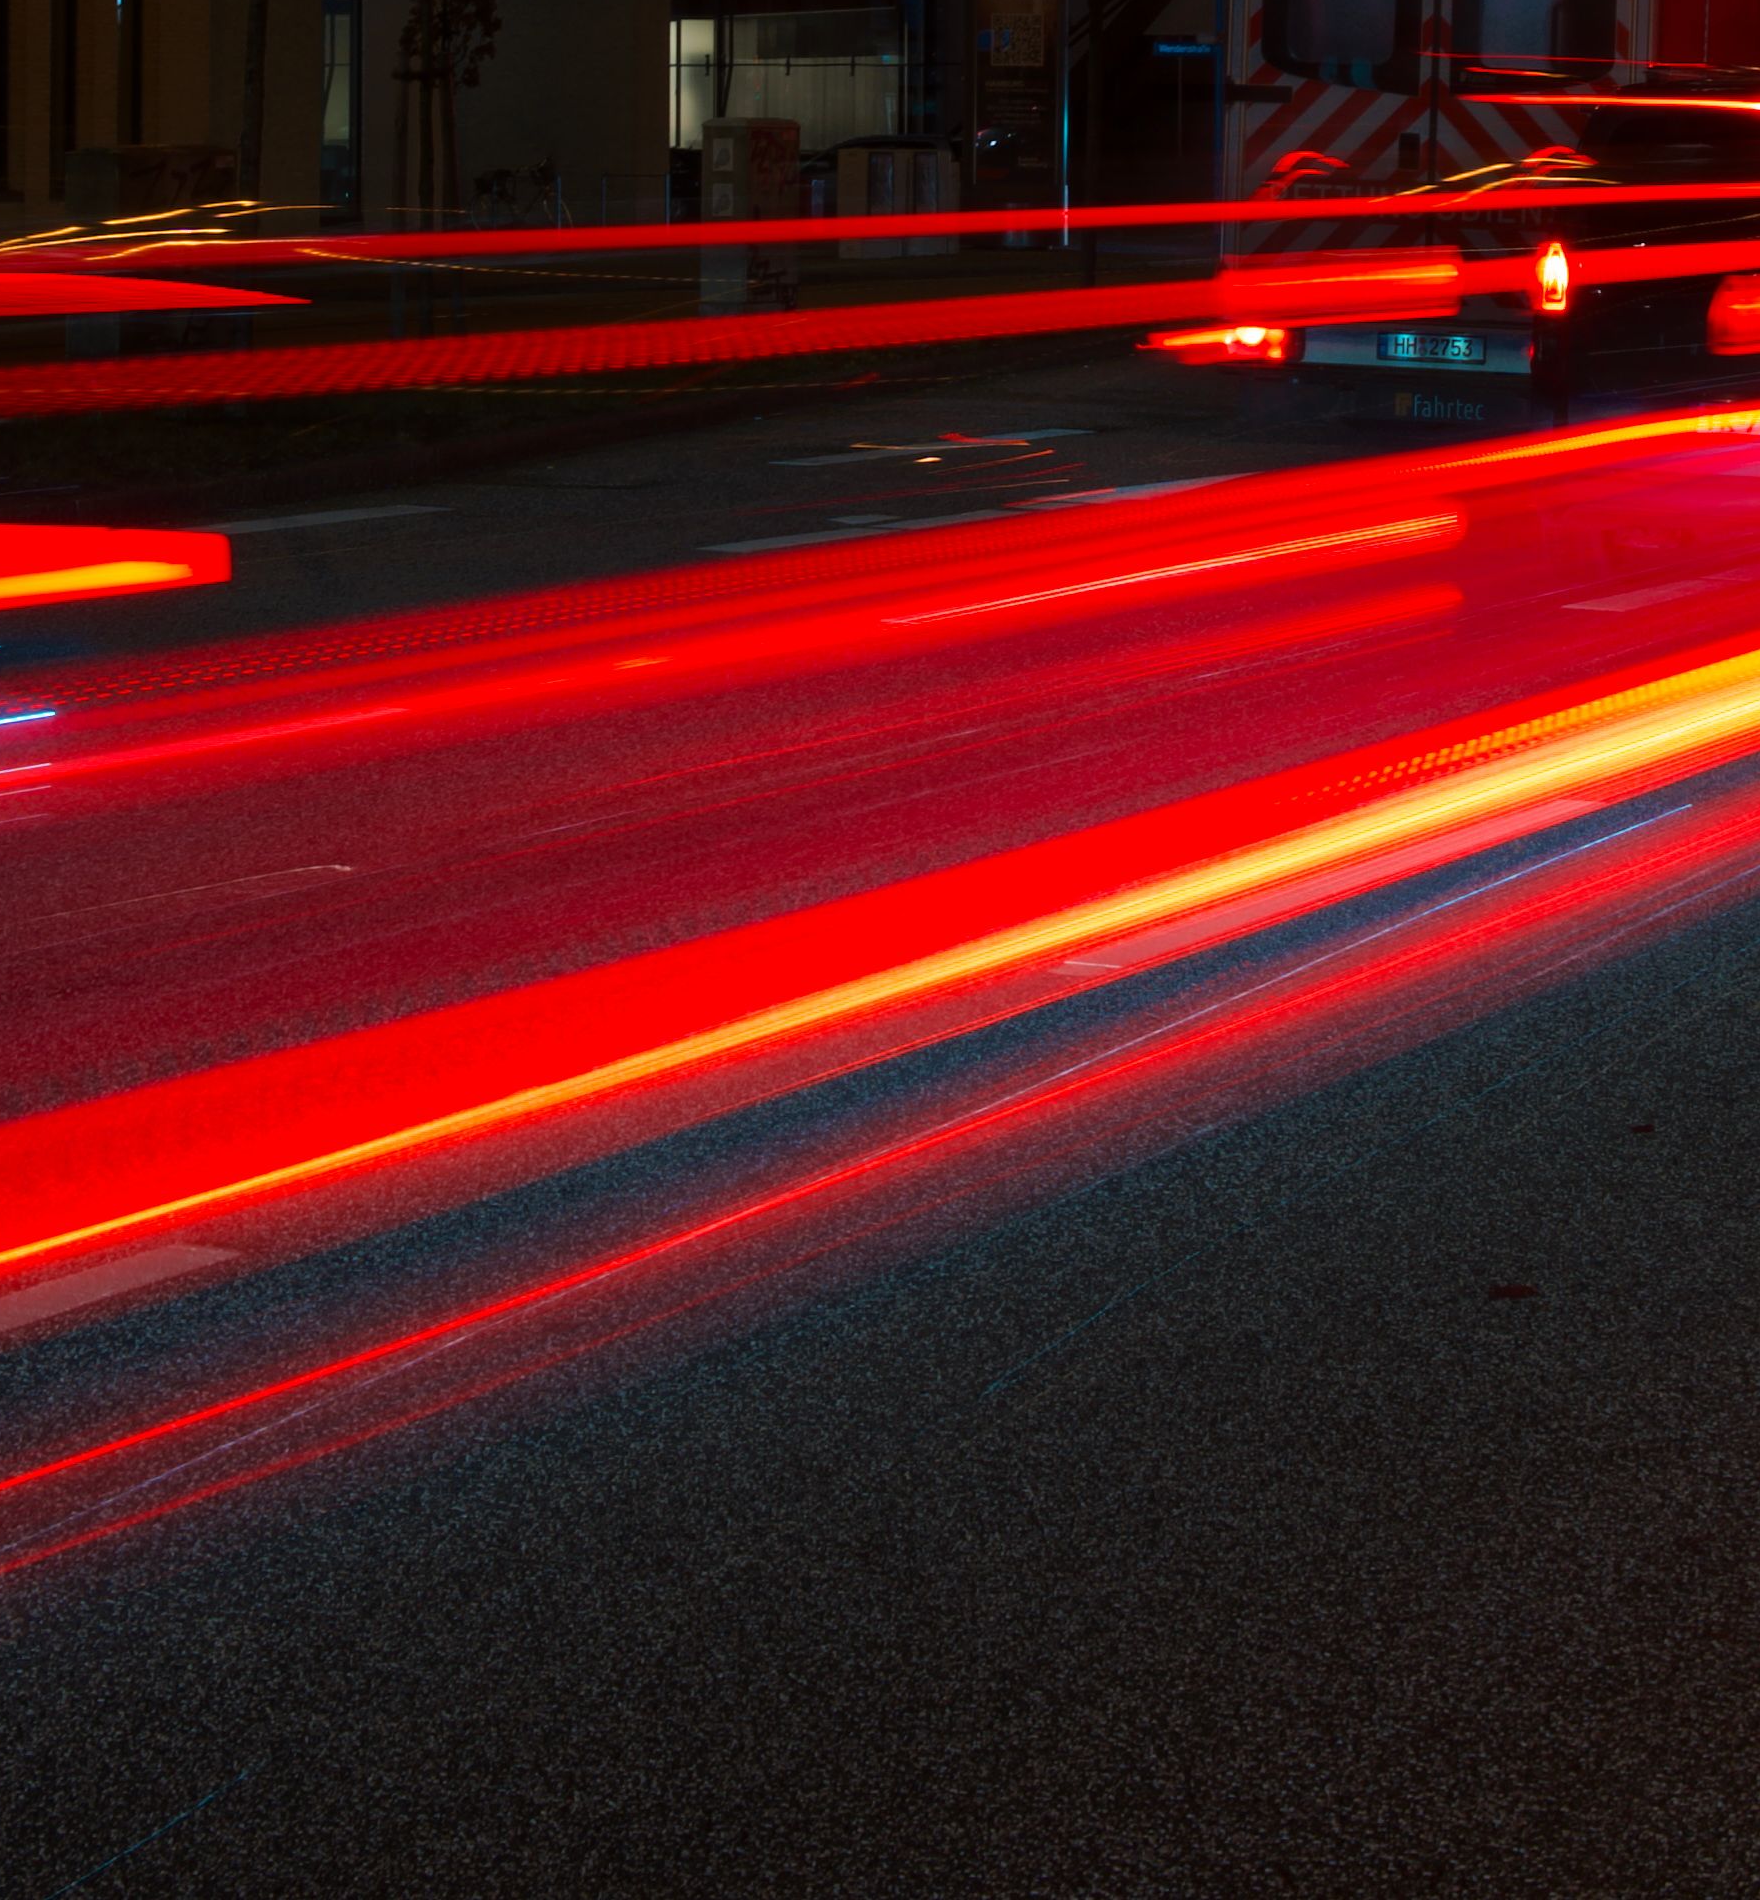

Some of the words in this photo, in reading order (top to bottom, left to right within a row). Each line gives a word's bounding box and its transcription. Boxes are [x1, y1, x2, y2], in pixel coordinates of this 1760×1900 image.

[1393, 336, 1418, 356] HH
[1429, 337, 1473, 358] 2753
[1413, 393, 1486, 421] fahrtec
